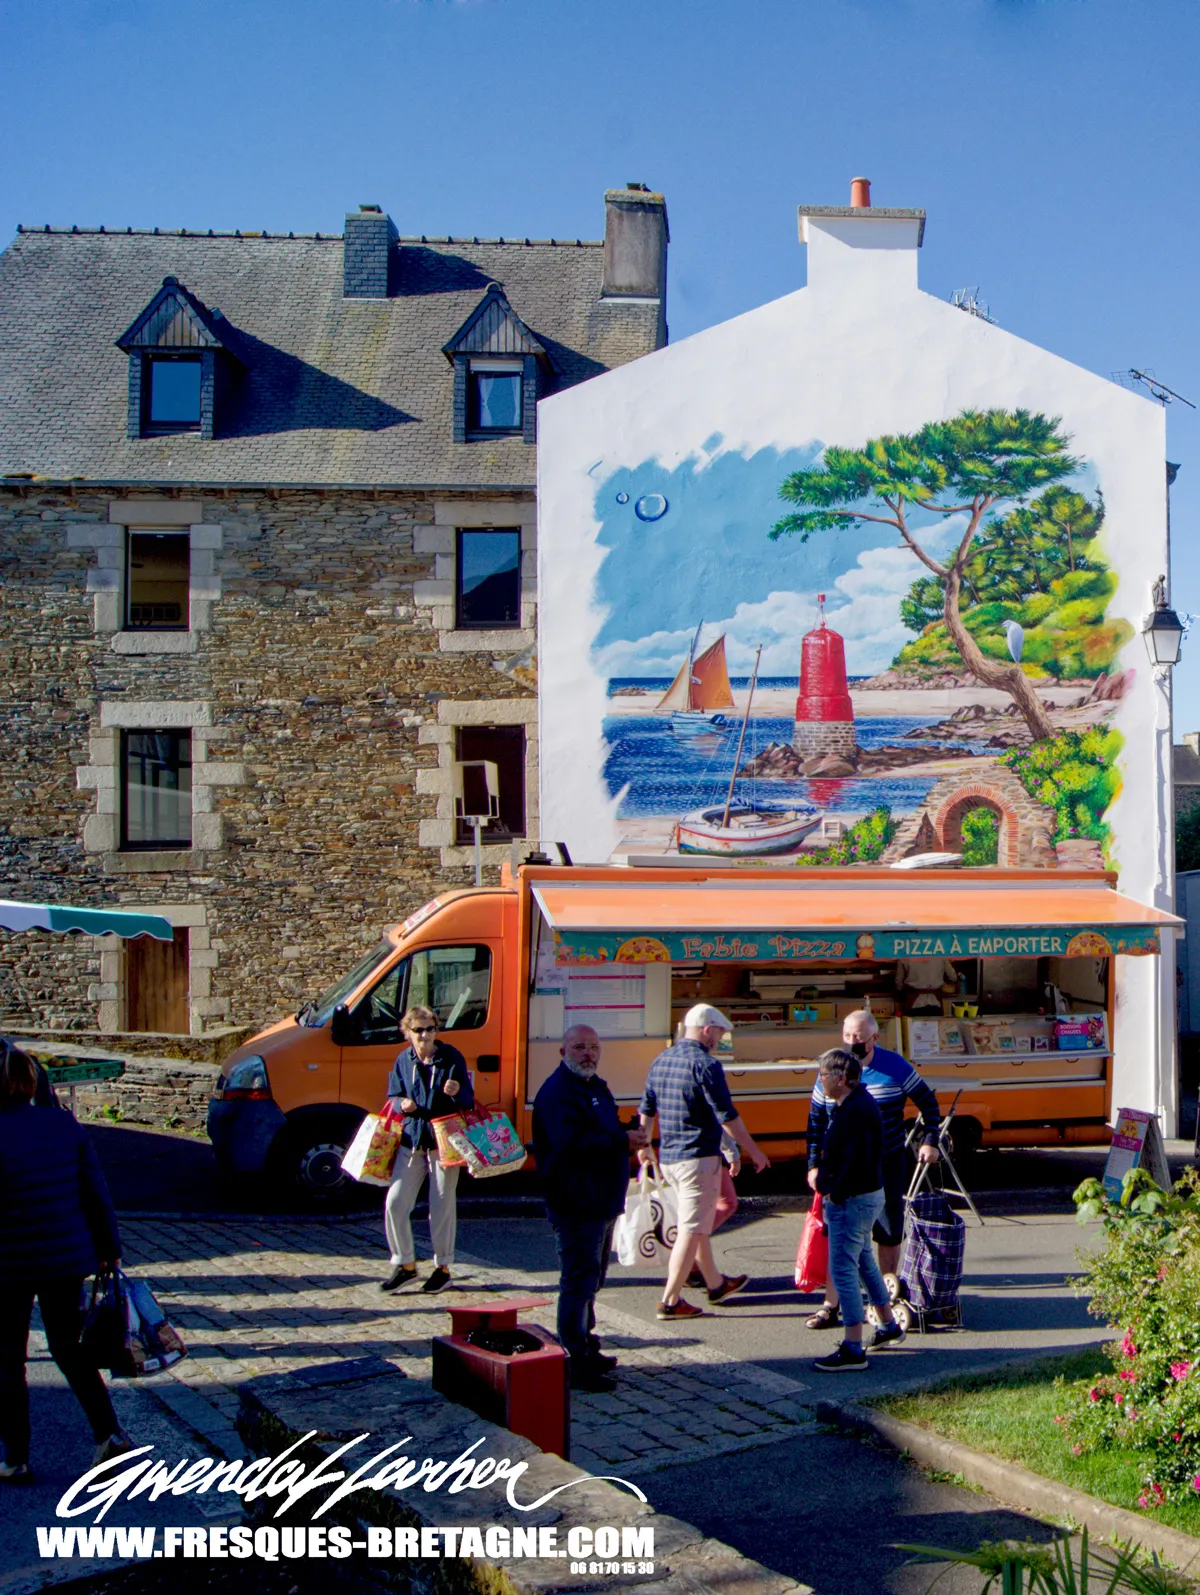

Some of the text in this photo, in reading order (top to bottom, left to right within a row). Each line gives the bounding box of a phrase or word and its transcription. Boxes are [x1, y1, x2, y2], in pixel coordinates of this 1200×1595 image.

[768, 935, 846, 957] Pizza
[893, 934, 1063, 955] PIZZA À EMPORTER
